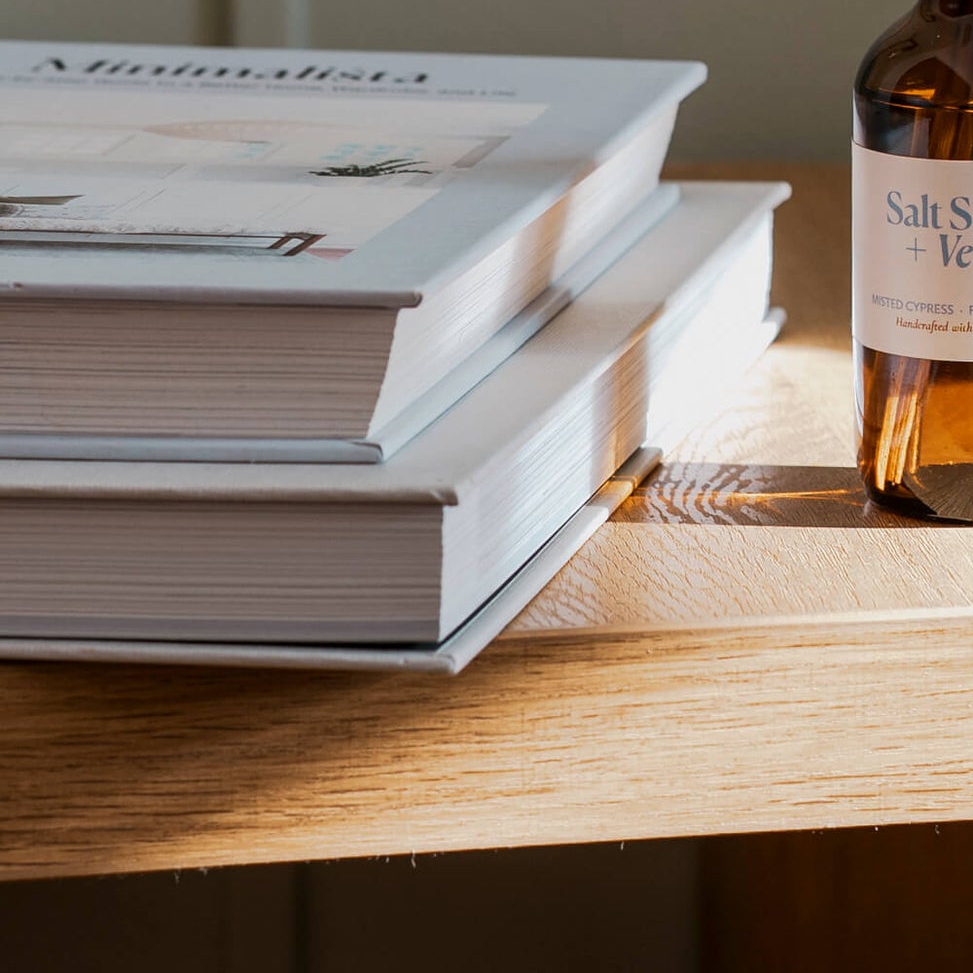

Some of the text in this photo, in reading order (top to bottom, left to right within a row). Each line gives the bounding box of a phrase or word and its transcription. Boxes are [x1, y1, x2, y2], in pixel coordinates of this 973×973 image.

[31, 55, 430, 84] Minimalista
[886, 190, 943, 229] Salt
[905, 237, 927, 262] +
[871, 293, 904, 310] MISTED
[905, 300, 954, 316] CYPRESS
[896, 316, 949, 334] Handcrafted
[951, 321, 973, 333] with
